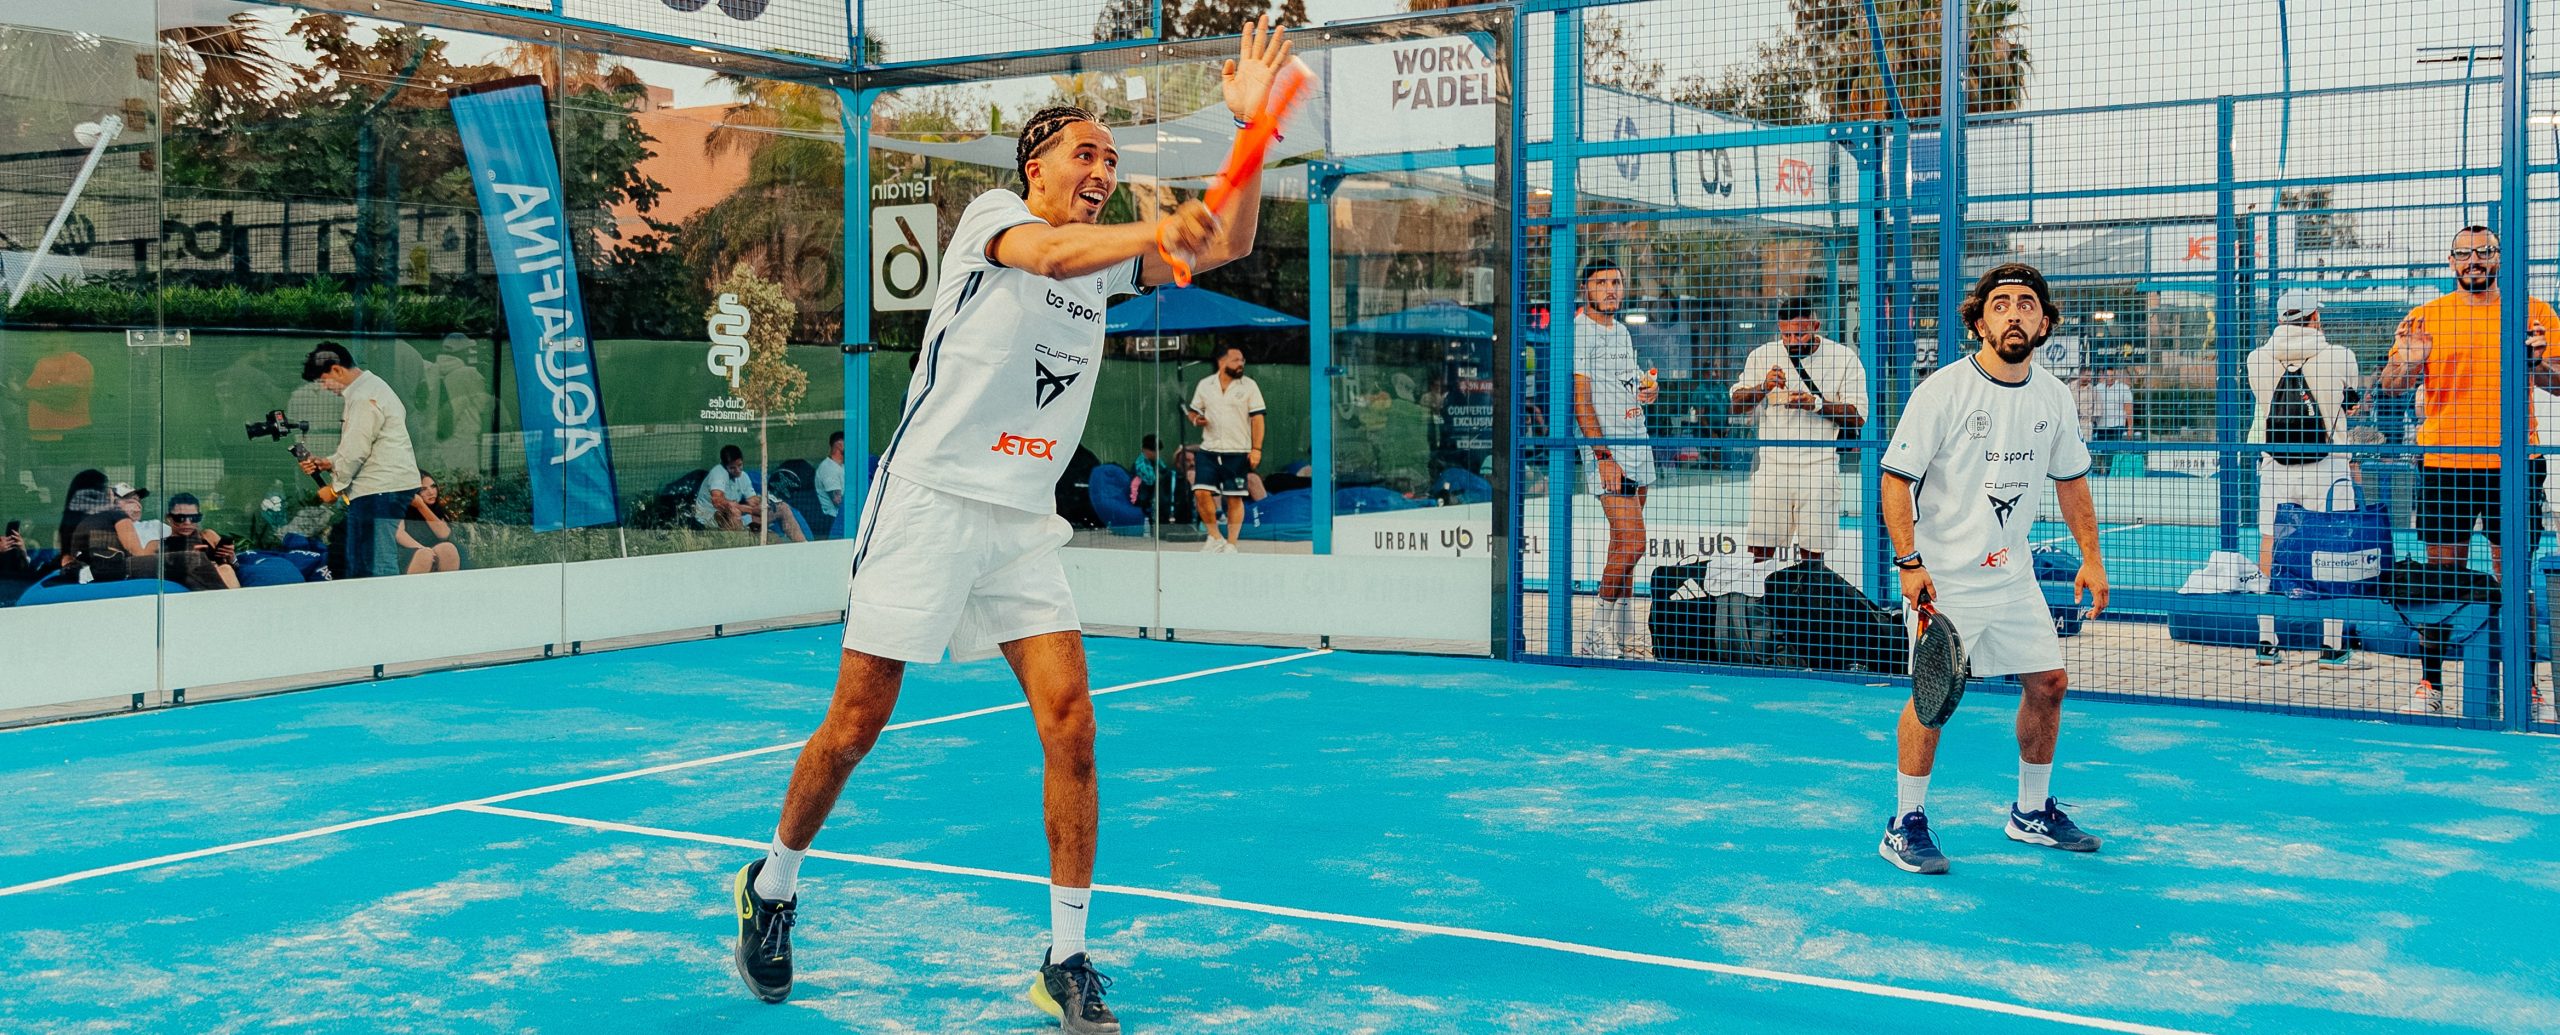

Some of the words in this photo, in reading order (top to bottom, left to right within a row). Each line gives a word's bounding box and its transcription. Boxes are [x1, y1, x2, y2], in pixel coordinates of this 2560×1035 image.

[1393, 44, 1474, 75] WORK
[1392, 73, 1496, 111] PADEL
[1035, 343, 1089, 366] CUPRA
[1448, 405, 1493, 415] COUVERTU
[1453, 417, 1493, 426] EXCLUSIV
[991, 432, 1058, 462] JETEX
[2004, 449, 2035, 464] sport
[1375, 531, 1428, 551] URBAN
[1650, 538, 1685, 558] BAN
[2315, 558, 2359, 567] Carrefour
[2239, 571, 2262, 584] sport
